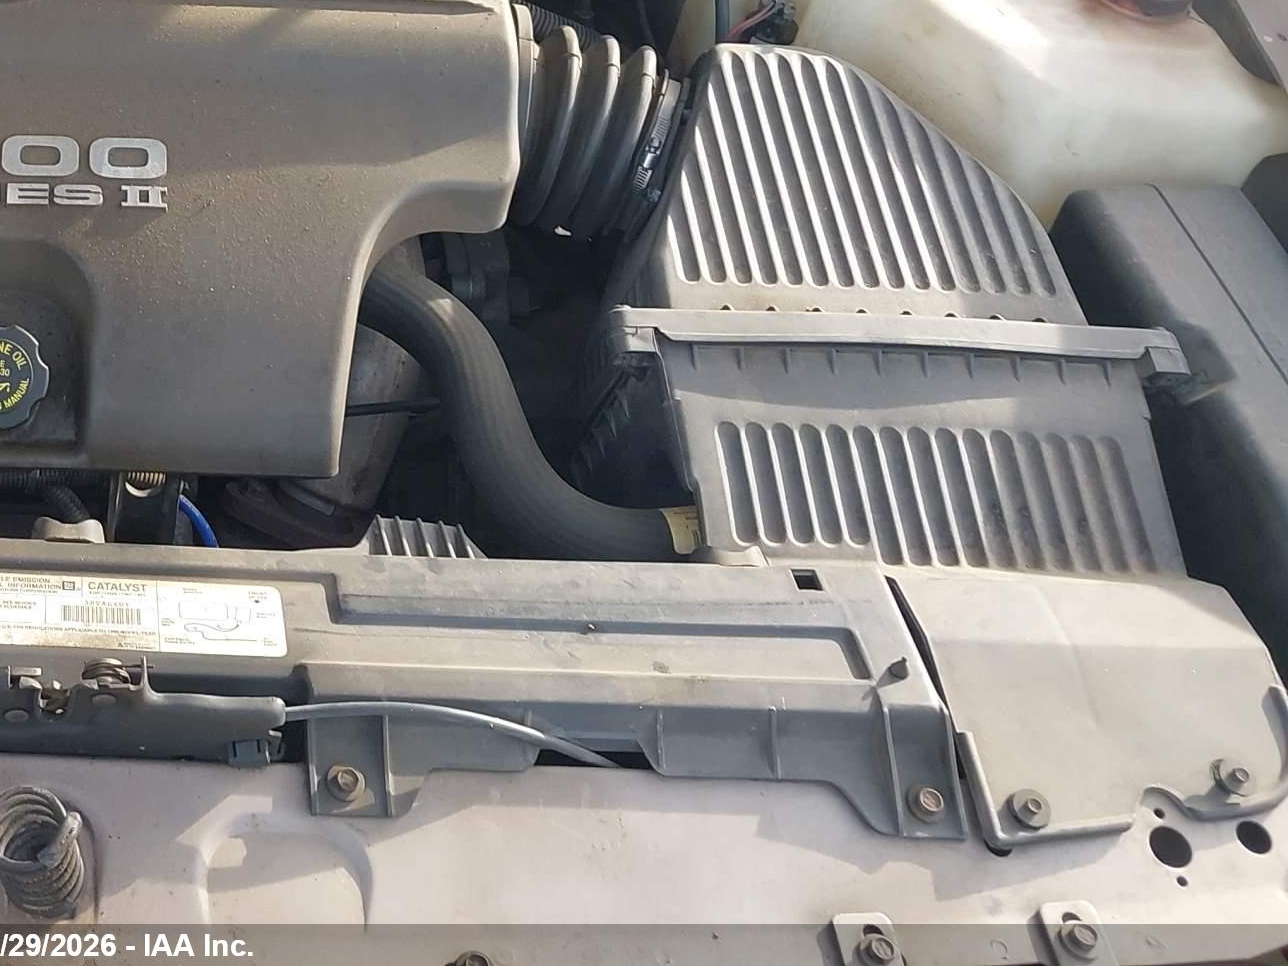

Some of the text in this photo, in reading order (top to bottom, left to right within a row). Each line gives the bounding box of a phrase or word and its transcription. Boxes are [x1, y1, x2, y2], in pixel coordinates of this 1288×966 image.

[120, 184, 169, 212] II
[12, 350, 28, 371] OIL
[4, 377, 30, 409] MANUAL
[7, 582, 61, 590] INFORMATION
[87, 580, 147, 593] CATALYST
